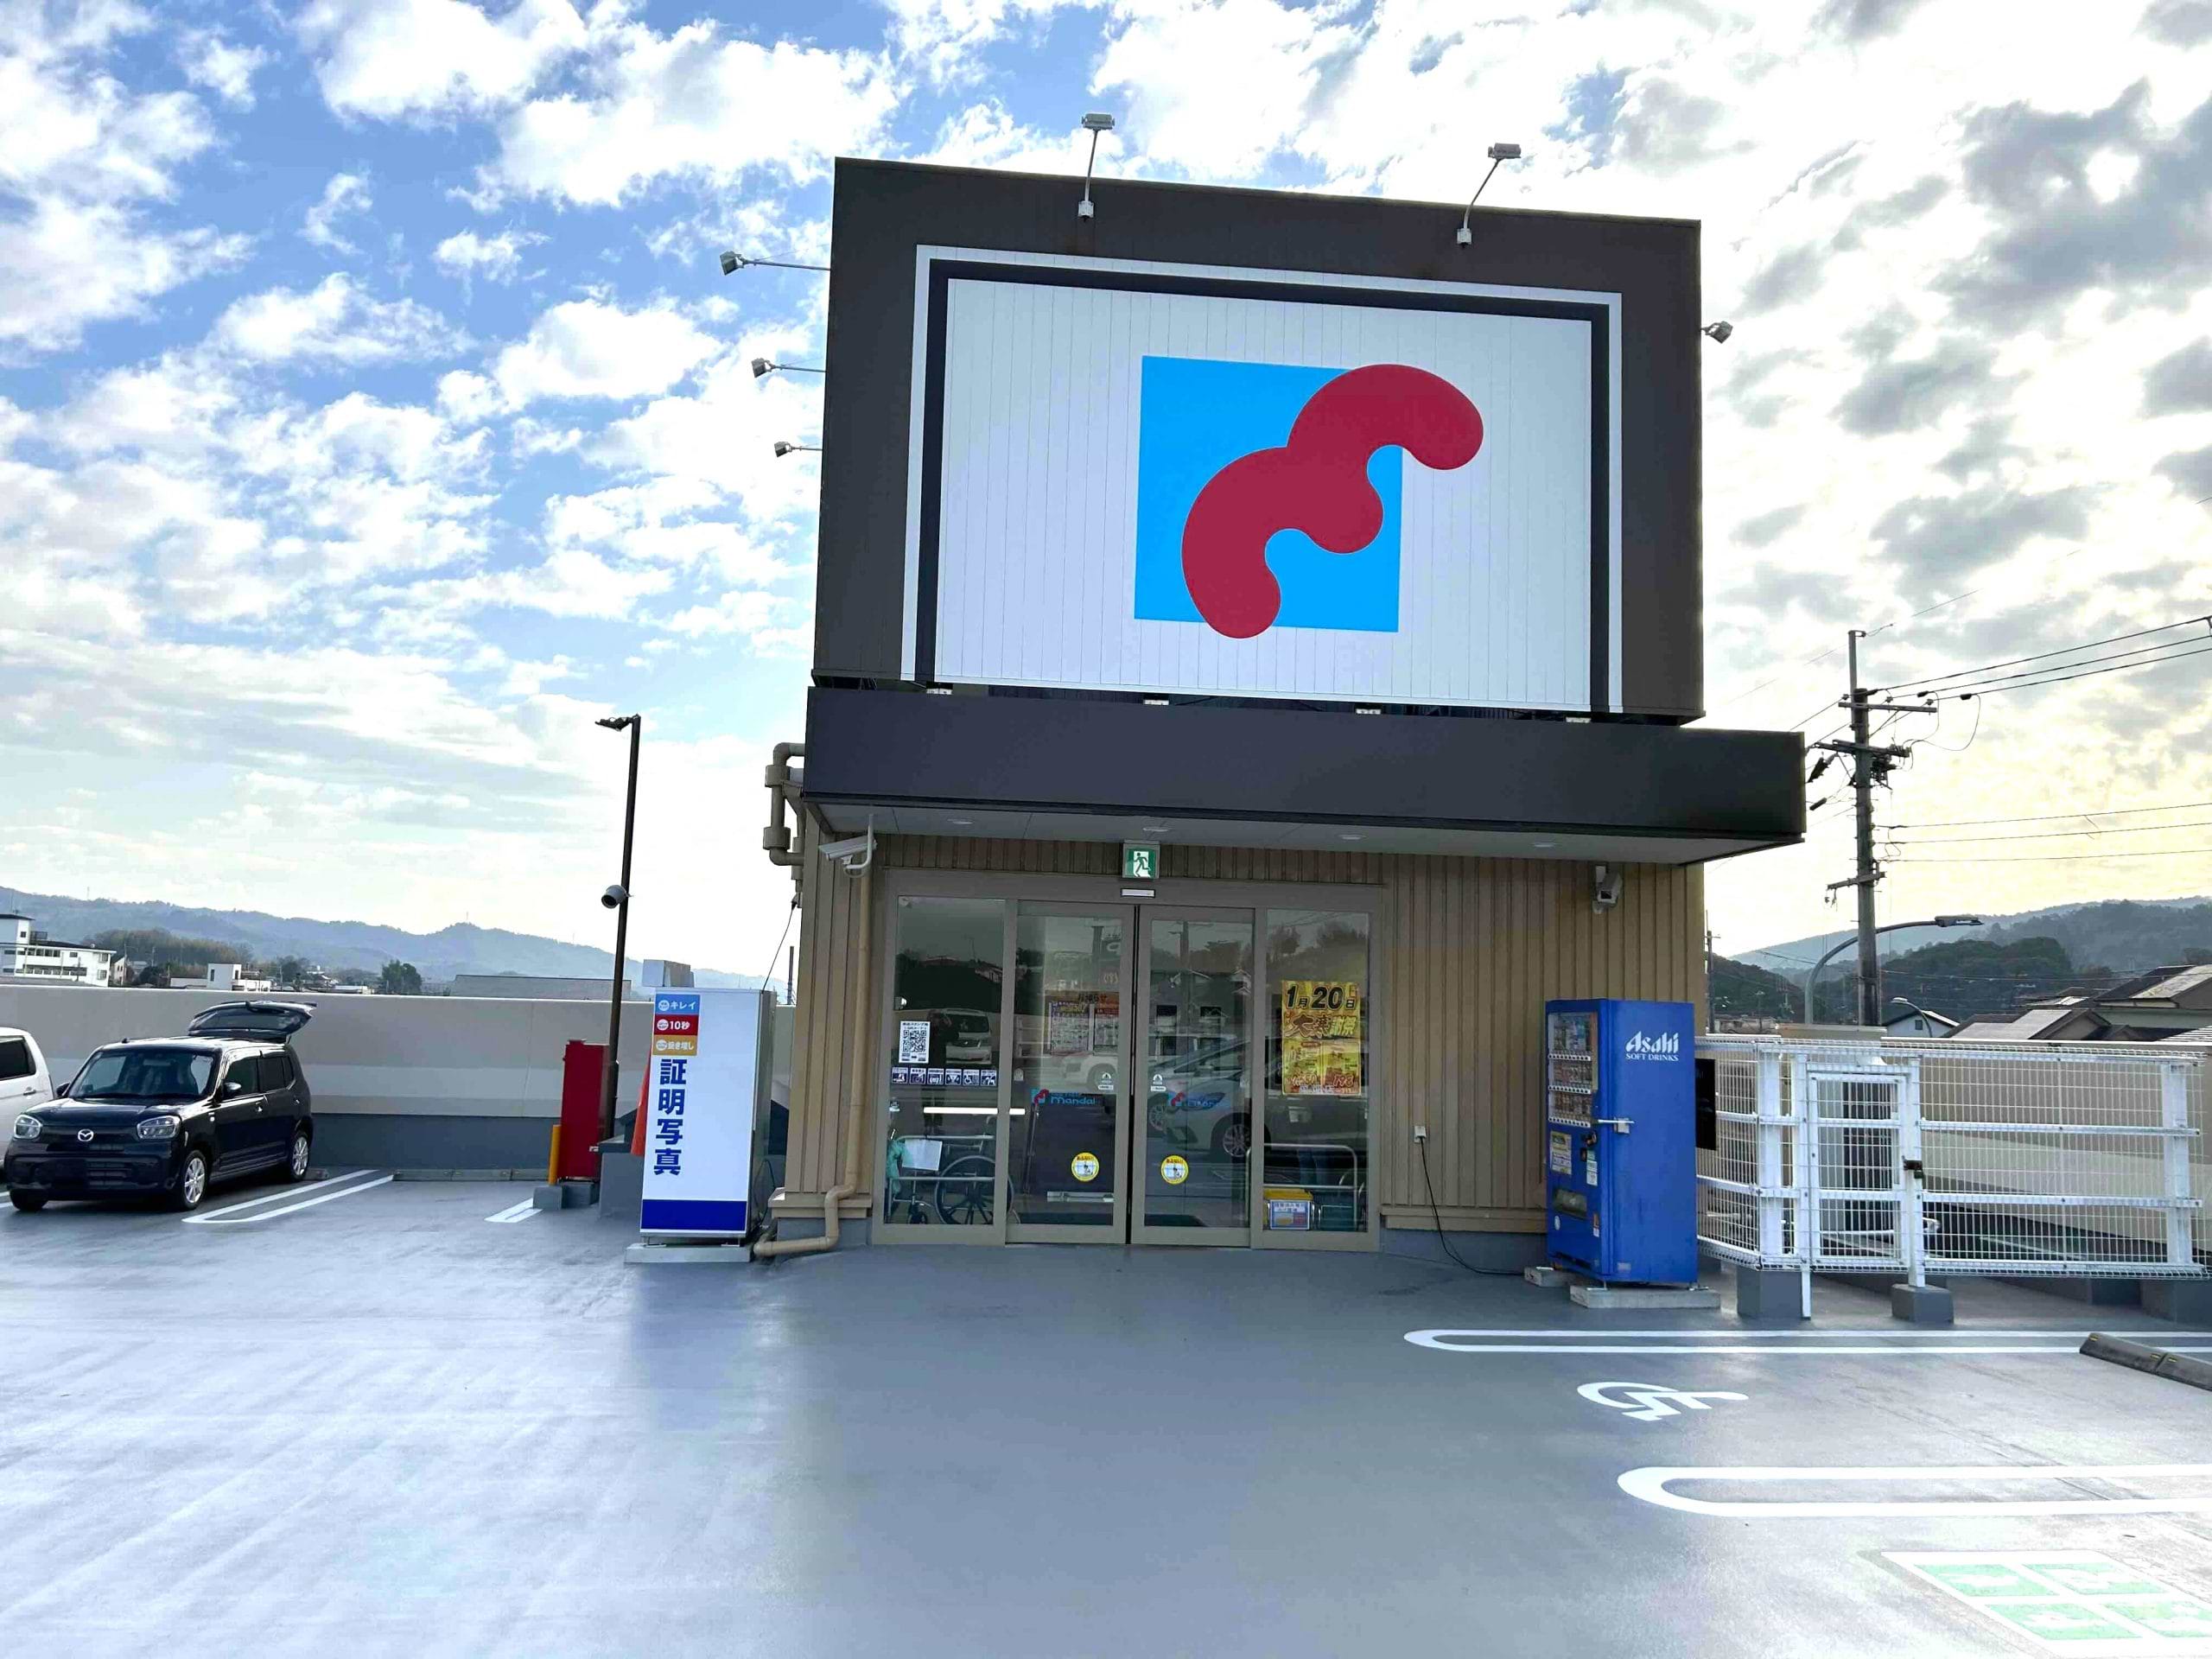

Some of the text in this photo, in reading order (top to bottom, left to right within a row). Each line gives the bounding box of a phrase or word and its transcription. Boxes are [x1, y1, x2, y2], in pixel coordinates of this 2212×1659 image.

[1286, 984, 1356, 1010] 1月20日
[671, 1001, 696, 1010] キレイ
[670, 1020, 690, 1030] 10秒
[1625, 1031, 1679, 1053] Asahi
[1625, 1052, 1679, 1062] SOFT DRINKS
[653, 1058, 688, 1176] 証明写真
